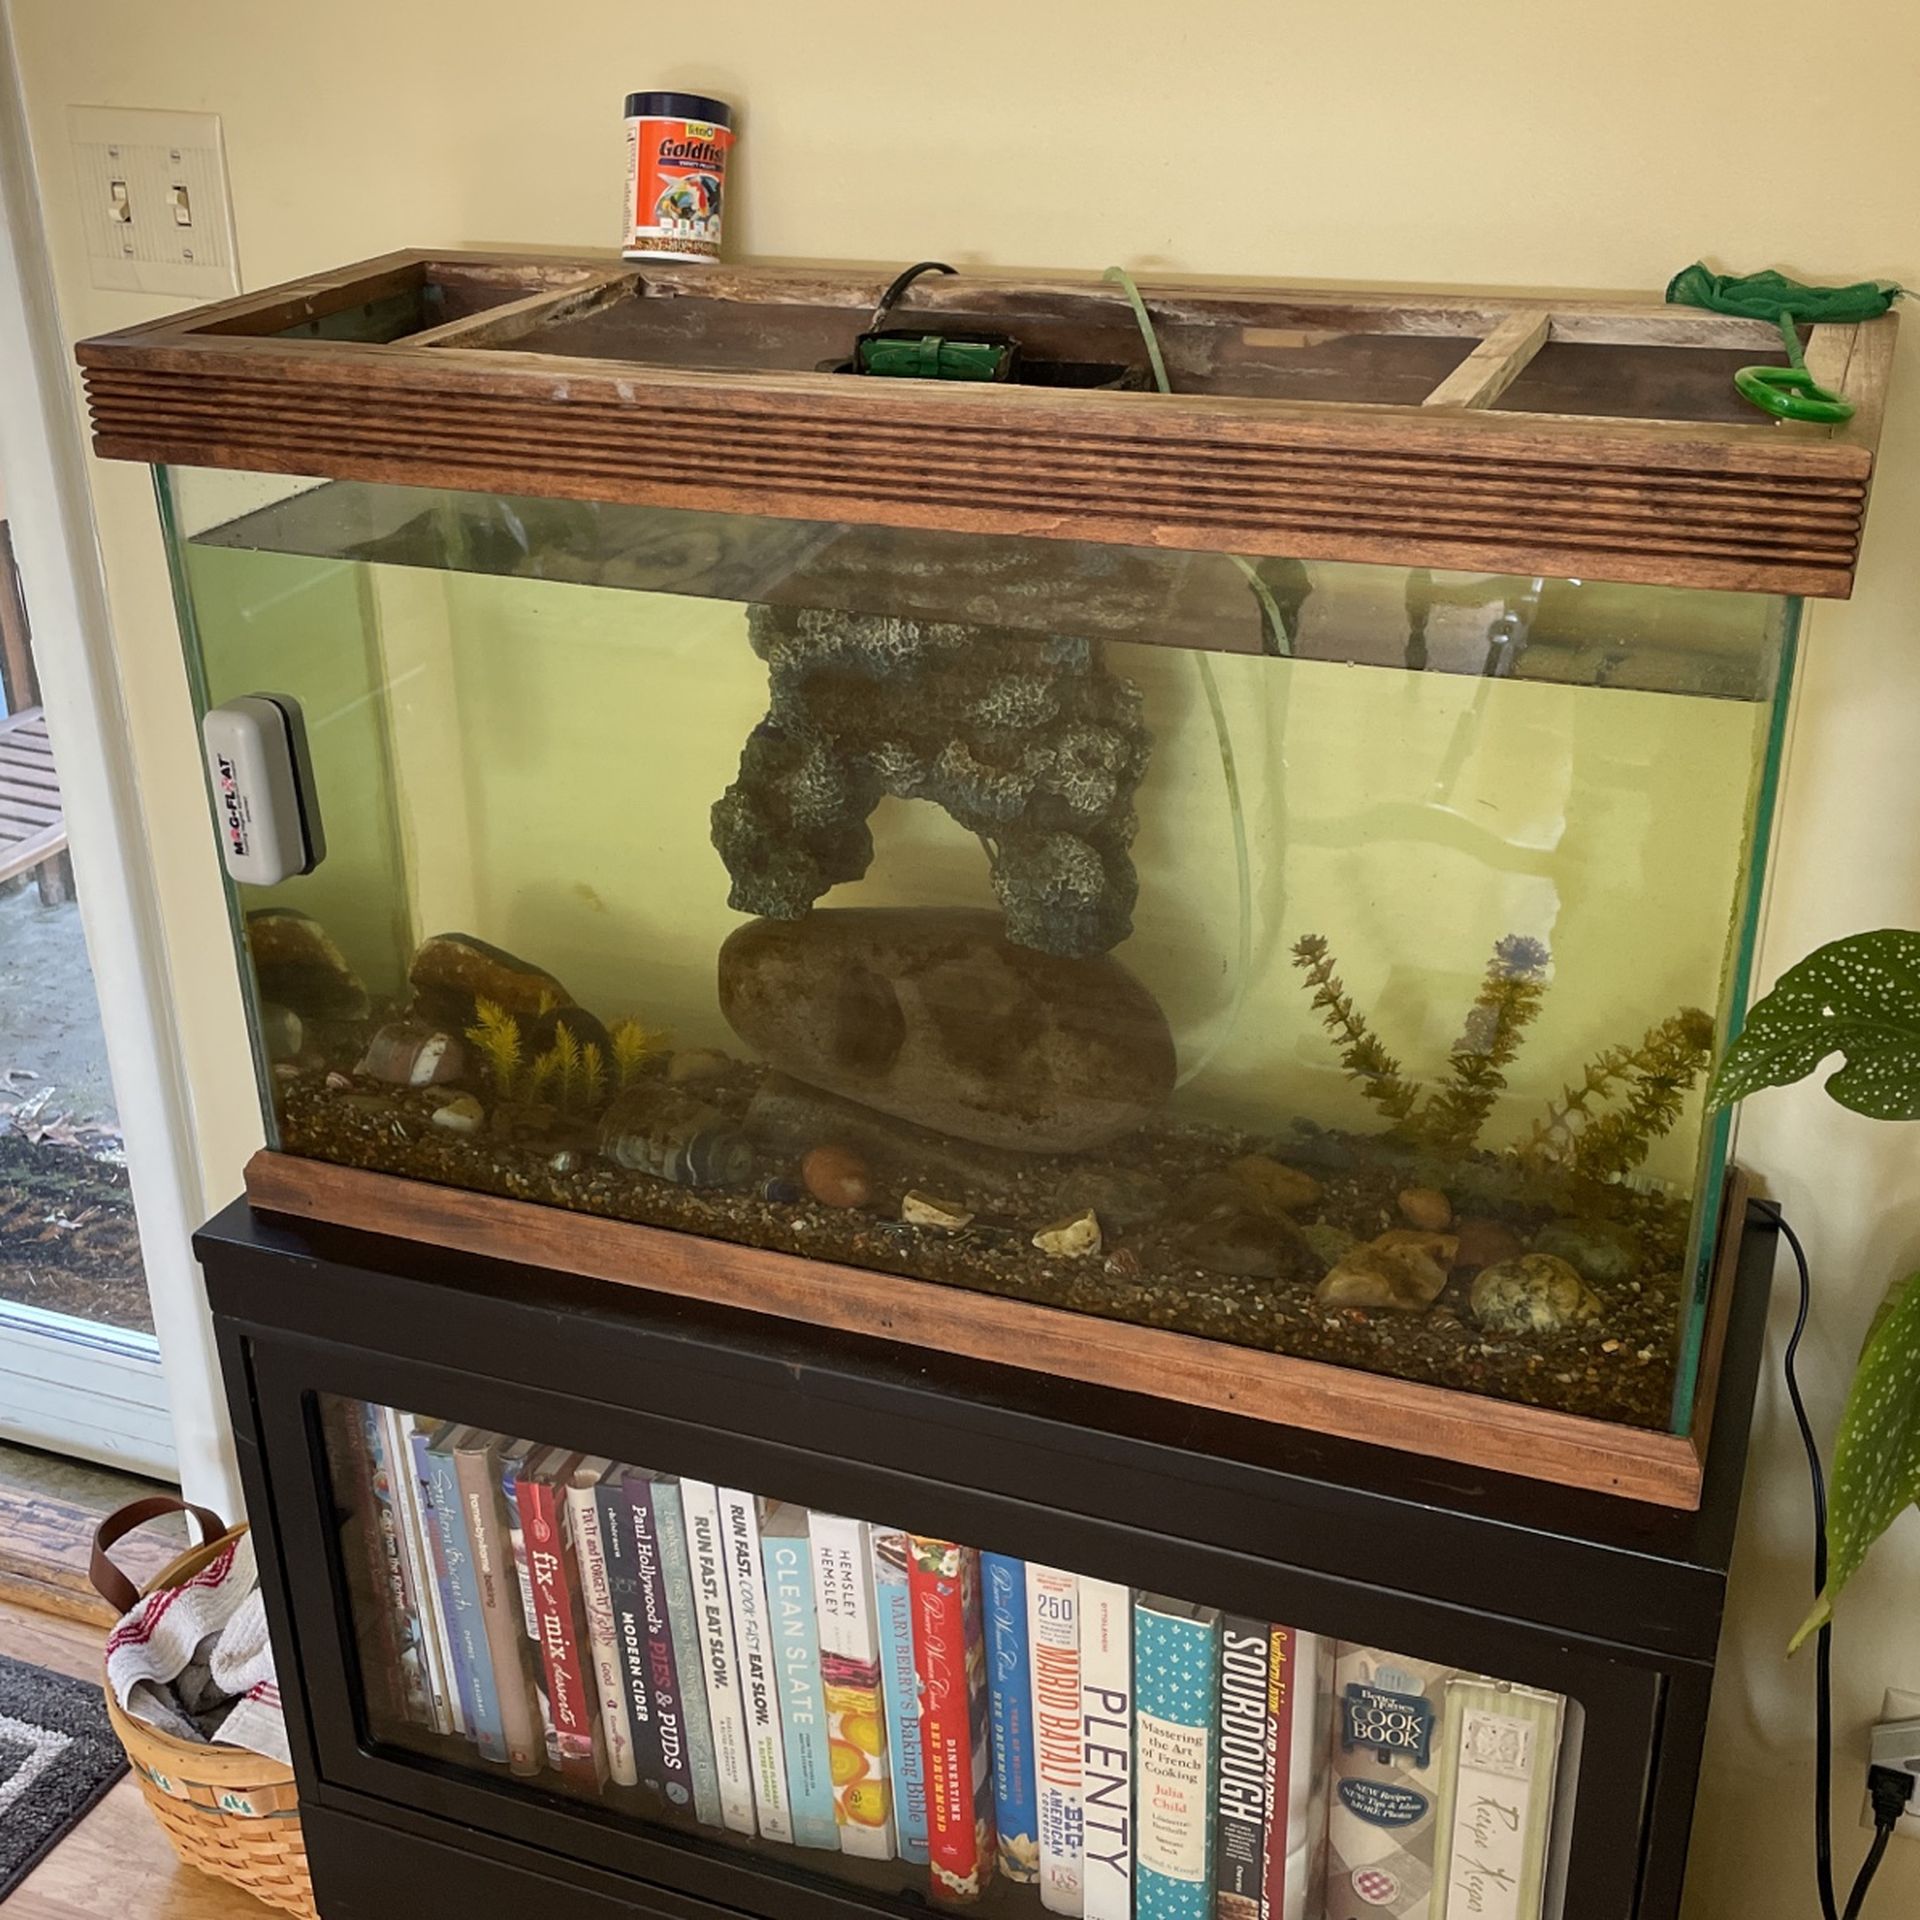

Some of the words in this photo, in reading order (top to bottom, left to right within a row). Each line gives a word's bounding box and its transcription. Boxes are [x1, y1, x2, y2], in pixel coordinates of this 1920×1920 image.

[431, 1470, 456, 1544] Southern
[444, 1547, 467, 1610] Biscuits
[632, 1504, 651, 1540] Paul
[694, 1516, 712, 1553] RUN
[730, 1504, 748, 1537] RUN
[390, 1558, 400, 1572] the
[587, 1538, 600, 1556] and
[734, 1539, 752, 1578] FAST.
[532, 1551, 558, 1586] fix
[637, 1542, 664, 1634] Hollywood's
[700, 1556, 718, 1600] FAST.
[820, 1548, 838, 1617] HEMSLEY
[838, 1550, 856, 1619] HEMSLEY
[483, 1574, 497, 1608] baking
[738, 1580, 756, 1618] COOK
[775, 1548, 805, 1636] CLEAN
[1038, 1594, 1072, 1621] 250
[706, 1604, 722, 1636] EAT
[890, 1595, 909, 1642] MARY
[921, 1592, 945, 1634] Pioneer
[994, 1608, 1018, 1650] Woman
[544, 1614, 570, 1660] mix
[745, 1619, 760, 1652] FAST
[1270, 1631, 1288, 1680] Southern
[600, 1662, 615, 1686] Good
[621, 1611, 642, 1675] MODERN
[632, 1678, 648, 1722] CIDER
[648, 1640, 671, 1688] PIES
[710, 1638, 728, 1690] SLOW.
[749, 1653, 764, 1680] EAT
[895, 1644, 914, 1710] BERRY'S
[924, 1635, 952, 1680] Woman
[996, 1650, 1017, 1682] Cooks
[1036, 1643, 1080, 1710] MARIO
[552, 1662, 576, 1728] desserts
[654, 1690, 672, 1707] &
[752, 1682, 769, 1726] SLOW.
[786, 1646, 814, 1725] SLATE
[927, 1678, 950, 1712] Cooks
[993, 1691, 1003, 1718] REE
[1268, 1679, 1286, 1716] Living
[1361, 1689, 1397, 1705] Better
[1371, 1698, 1416, 1714] Homes
[657, 1710, 682, 1770] PUDS
[930, 1722, 941, 1750] REE
[1141, 1719, 1204, 1747] Mastering
[1220, 1630, 1268, 1825] SOURDOUGH
[1351, 1704, 1423, 1735] COOK
[1354, 1721, 1420, 1749] BOOK
[900, 1716, 922, 1778] Baking
[994, 1724, 1007, 1801] DRUMMOND
[1039, 1712, 1082, 1788] BATALI
[1142, 1747, 1154, 1758] of
[1158, 1750, 1202, 1770] French
[1149, 1736, 1168, 1751] the
[1172, 1741, 1193, 1756] Art
[932, 1754, 946, 1832] DRUMMOND
[946, 1739, 960, 1822] DINNERTIME
[1084, 1685, 1128, 1878] PLENTY
[1144, 1761, 1198, 1784] Cooking
[1154, 1784, 1184, 1799] Julia
[1355, 1782, 1380, 1797] NEW
[1380, 1790, 1413, 1803] Recipes
[906, 1781, 925, 1823] Bible
[1041, 1792, 1050, 1846] COOKBOOK
[1152, 1797, 1187, 1814] Child
[1342, 1787, 1368, 1803] NEW
[1368, 1797, 1386, 1810] Tips
[1398, 1802, 1422, 1812] Ideas
[1350, 1800, 1382, 1816] MORE
[1382, 1809, 1413, 1820] Photos
[1050, 1788, 1064, 1858] AMERICAN
[1064, 1806, 1084, 1850] BIG
[1460, 1796, 1520, 1848] Recipe
[1455, 1854, 1516, 1912] Keeper
